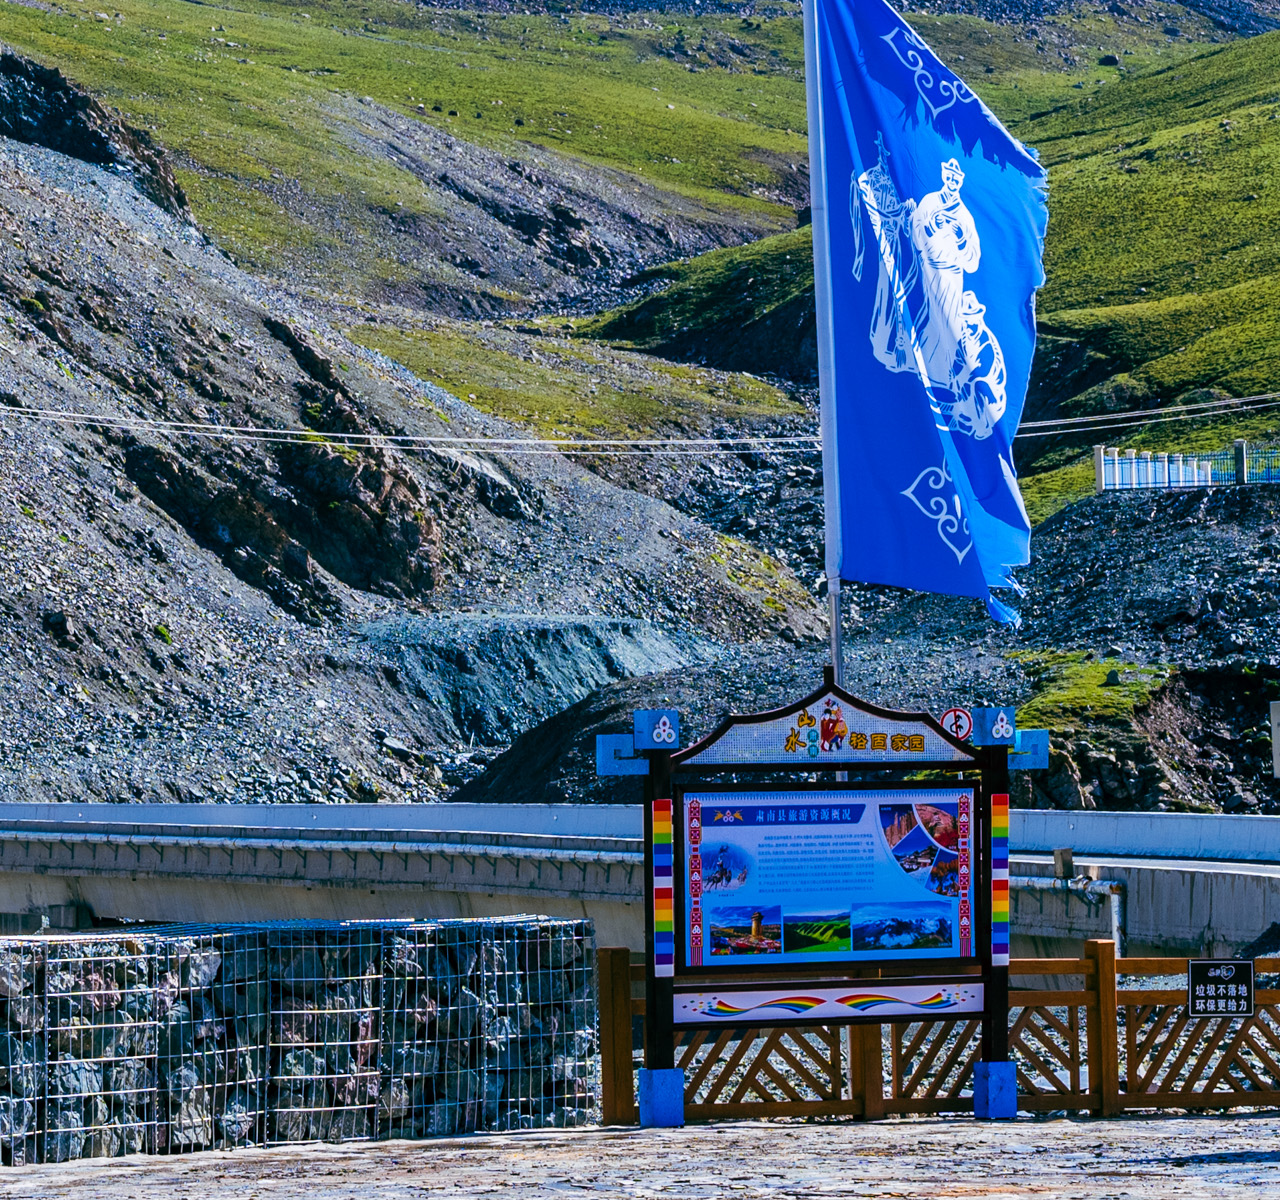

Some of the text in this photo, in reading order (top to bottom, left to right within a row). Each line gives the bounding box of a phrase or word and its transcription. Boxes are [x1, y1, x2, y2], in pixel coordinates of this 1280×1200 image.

[849, 731, 925, 753] 裕固家园
[755, 808, 852, 822] 肃南县旅游资源概况
[1195, 984, 1248, 997] 垃圾不落地
[1195, 999, 1248, 1012] 环保更给力
